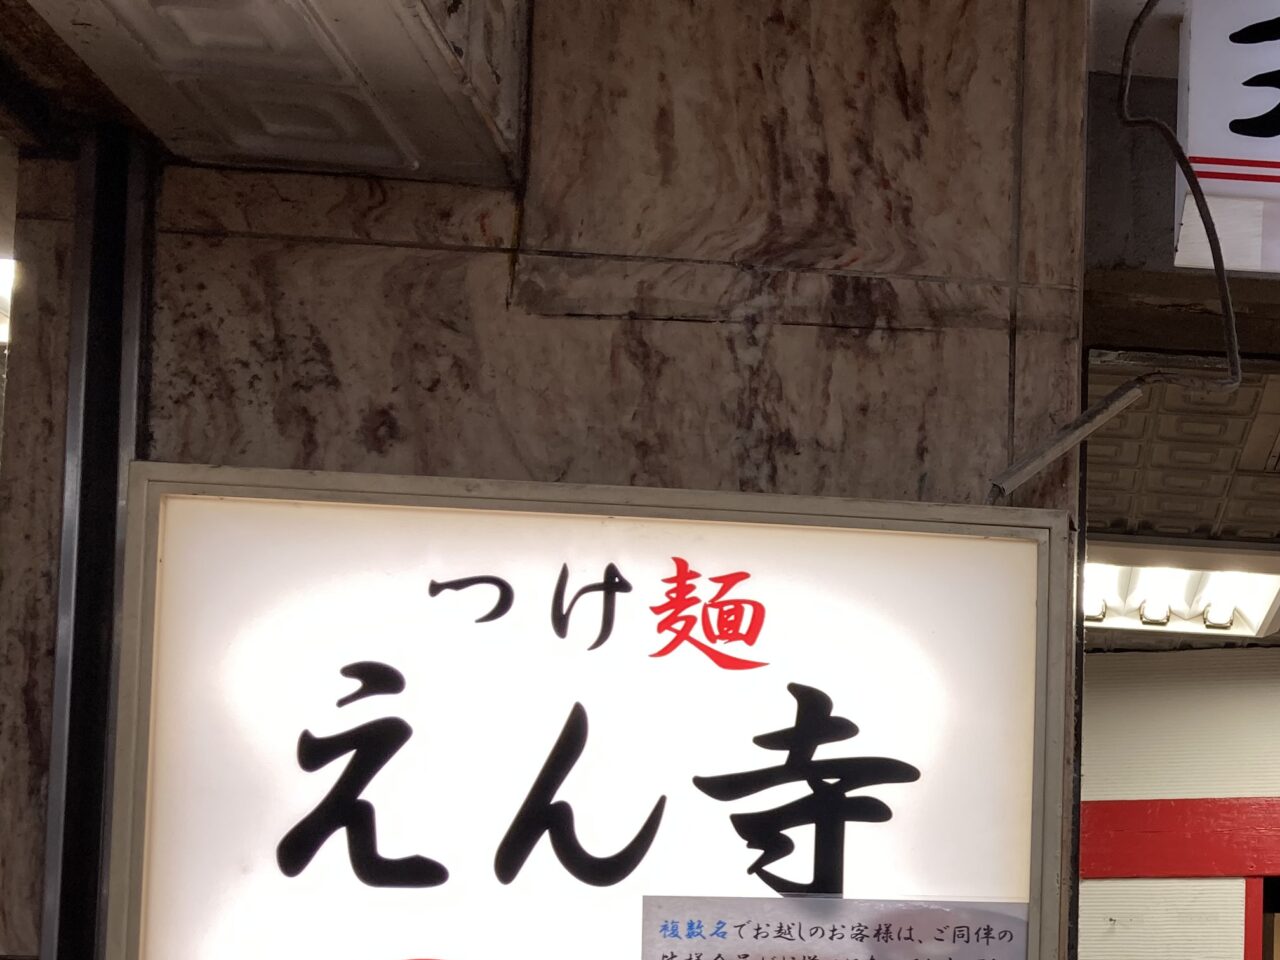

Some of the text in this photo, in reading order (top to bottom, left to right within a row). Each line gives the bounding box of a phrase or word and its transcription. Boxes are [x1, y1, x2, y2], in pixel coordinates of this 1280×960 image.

[428, 556, 770, 670] つけ麺
[276, 658, 922, 897] えん寺
